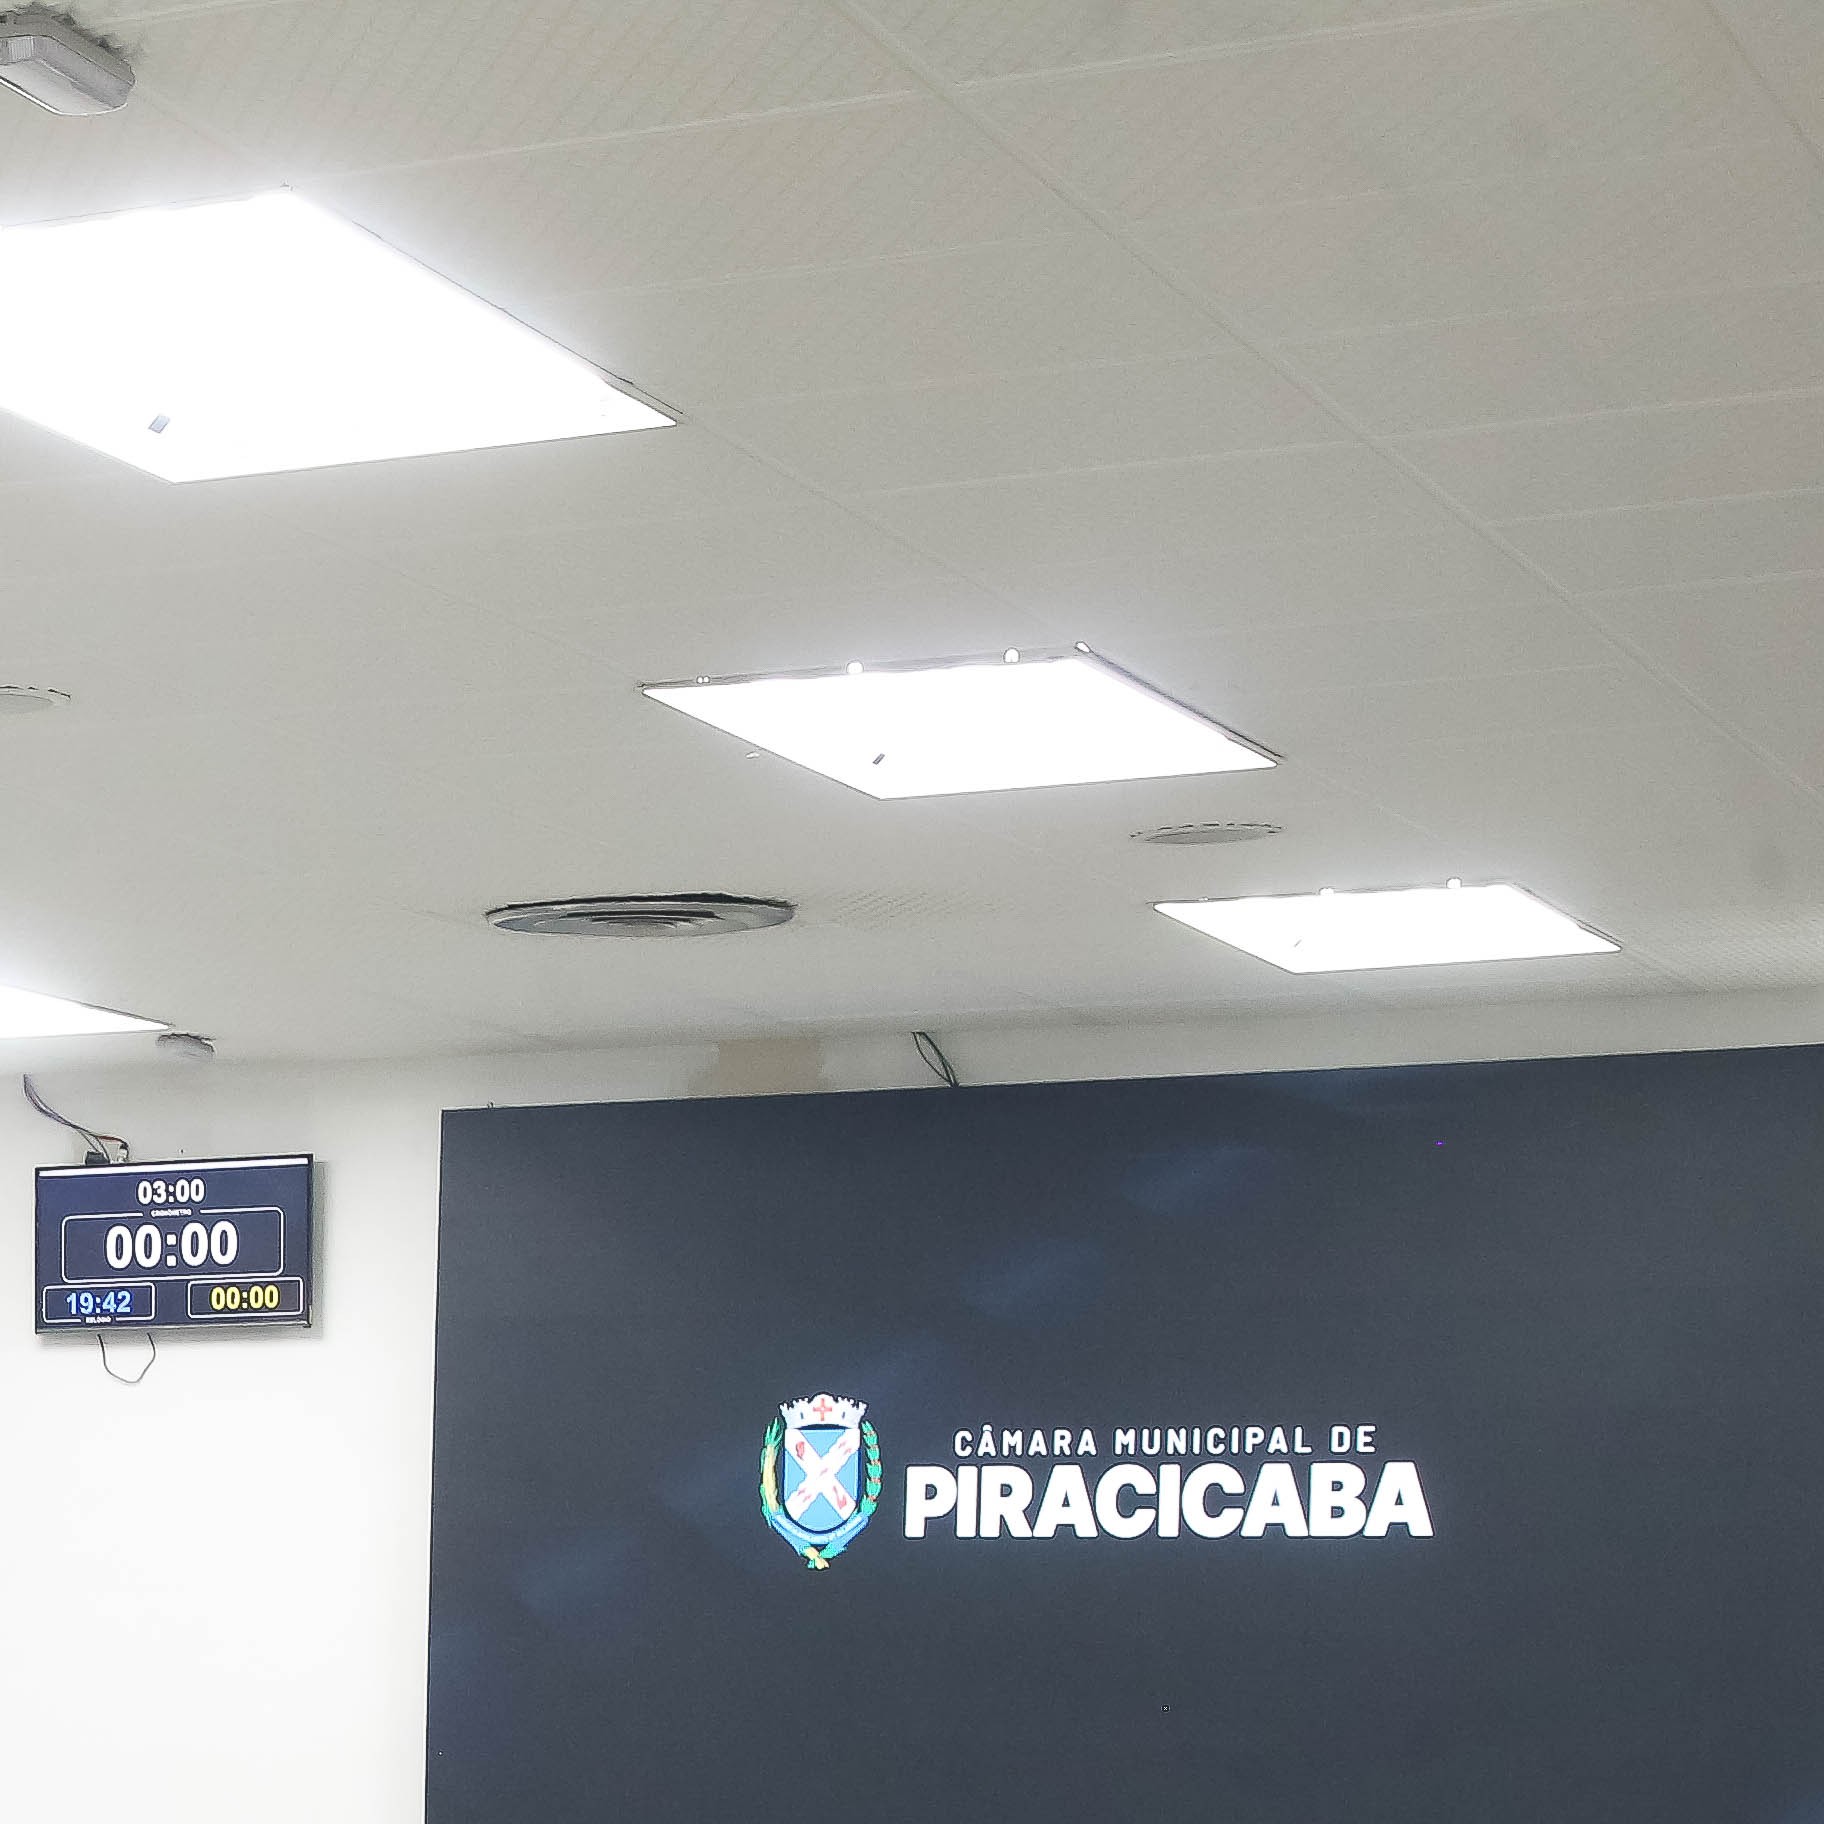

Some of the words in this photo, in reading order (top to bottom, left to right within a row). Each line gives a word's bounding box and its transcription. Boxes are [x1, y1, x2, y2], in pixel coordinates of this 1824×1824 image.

[137, 1178, 205, 1204] 03:00
[106, 1221, 239, 1269] 00:00
[66, 1291, 132, 1315] 19:42
[210, 1285, 280, 1311] 00:00
[953, 1424, 1097, 1456] CÂMARA
[1114, 1426, 1313, 1455] MUNICIPAL
[1329, 1425, 1377, 1454] DE
[904, 1461, 1433, 1539] PIRACICABA
